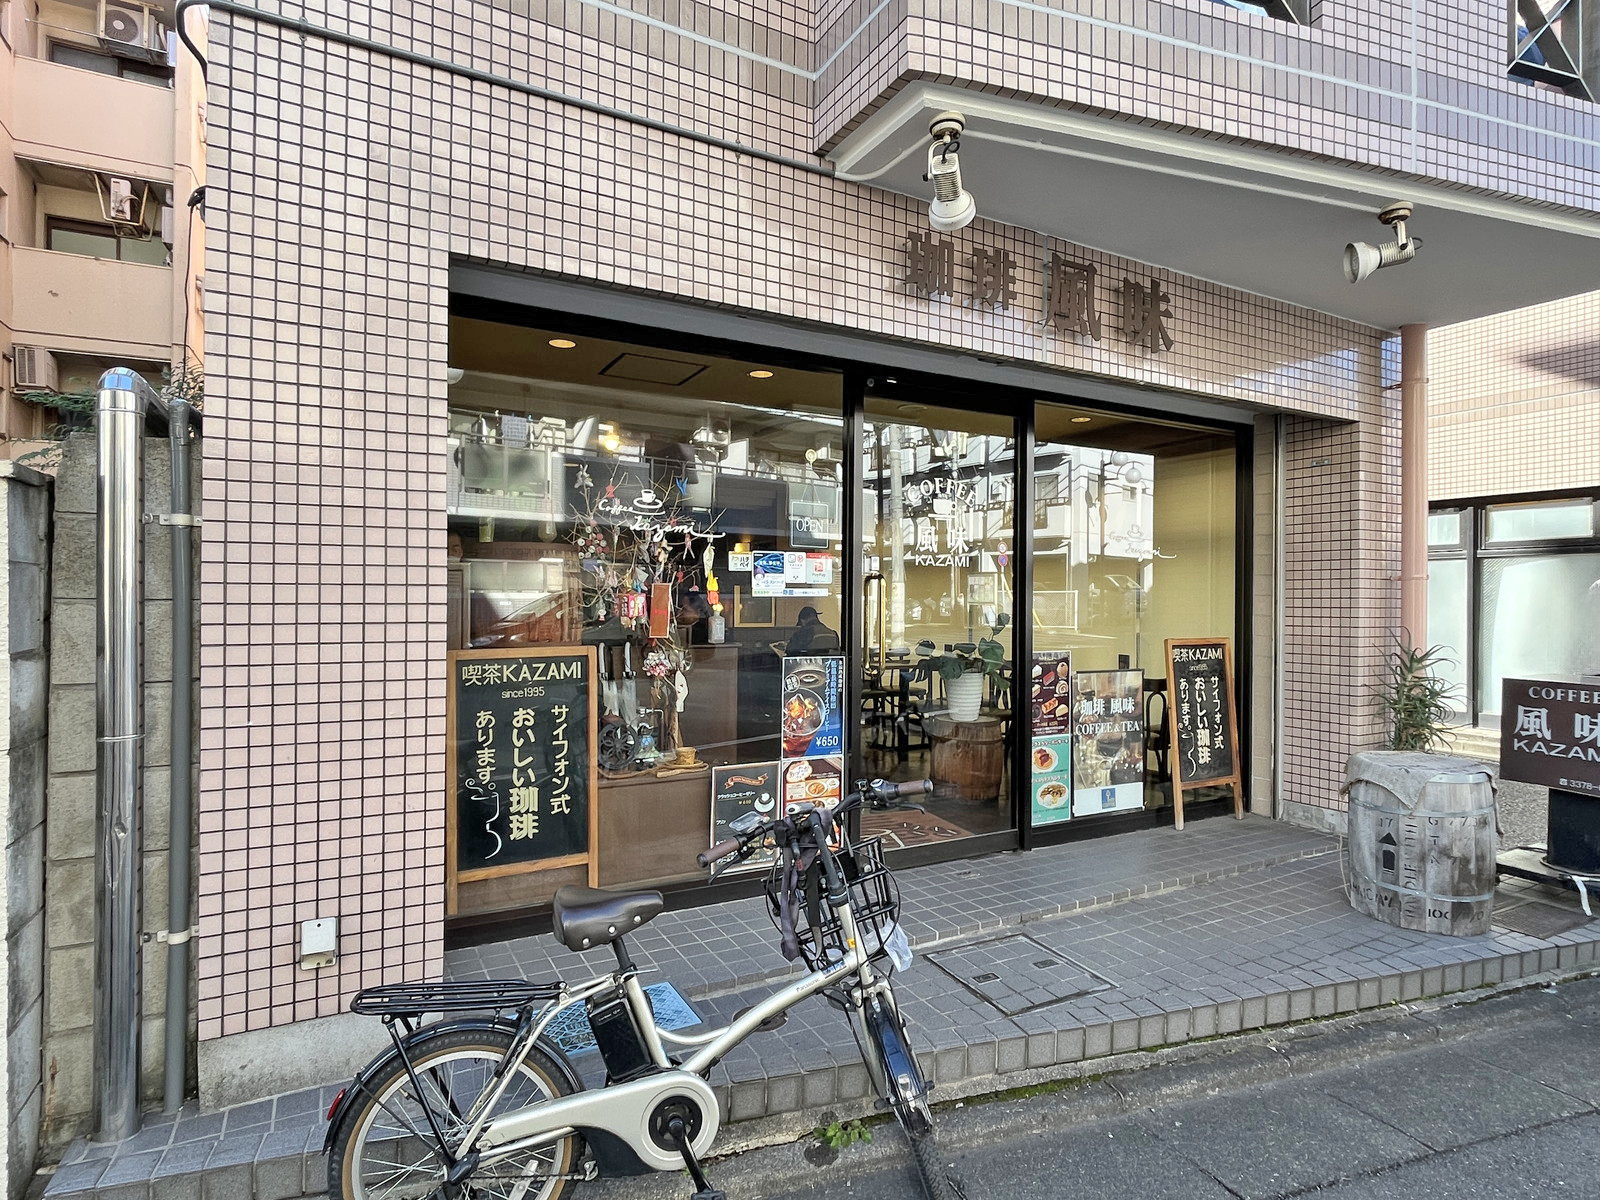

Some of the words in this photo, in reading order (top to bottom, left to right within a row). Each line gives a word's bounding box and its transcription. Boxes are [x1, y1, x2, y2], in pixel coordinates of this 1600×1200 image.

[907, 477, 977, 508] COFFEE
[599, 499, 652, 515] Coffee
[796, 517, 824, 532] OPEN
[915, 525, 969, 553] 風味
[915, 554, 970, 568] KAZAMI
[1173, 648, 1223, 662] 喫茶KAZAMI
[462, 661, 582, 686] 喫茶KAZAMI
[501, 686, 545, 699] since1995
[1528, 686, 1600, 704] COFFEE
[1080, 697, 1105, 716] 珈琲
[1110, 696, 1135, 715] 風味
[1179, 678, 1191, 731] あります。
[1210, 675, 1224, 749] サイフォン式
[1076, 722, 1113, 736] COFFEE
[1121, 720, 1140, 732] TEA
[1194, 677, 1211, 764] おいしい珈琲
[475, 710, 497, 791] あります。
[815, 735, 839, 747] ¥650
[550, 704, 571, 815] サイフォン式
[509, 707, 539, 841] おいしい珈琲
